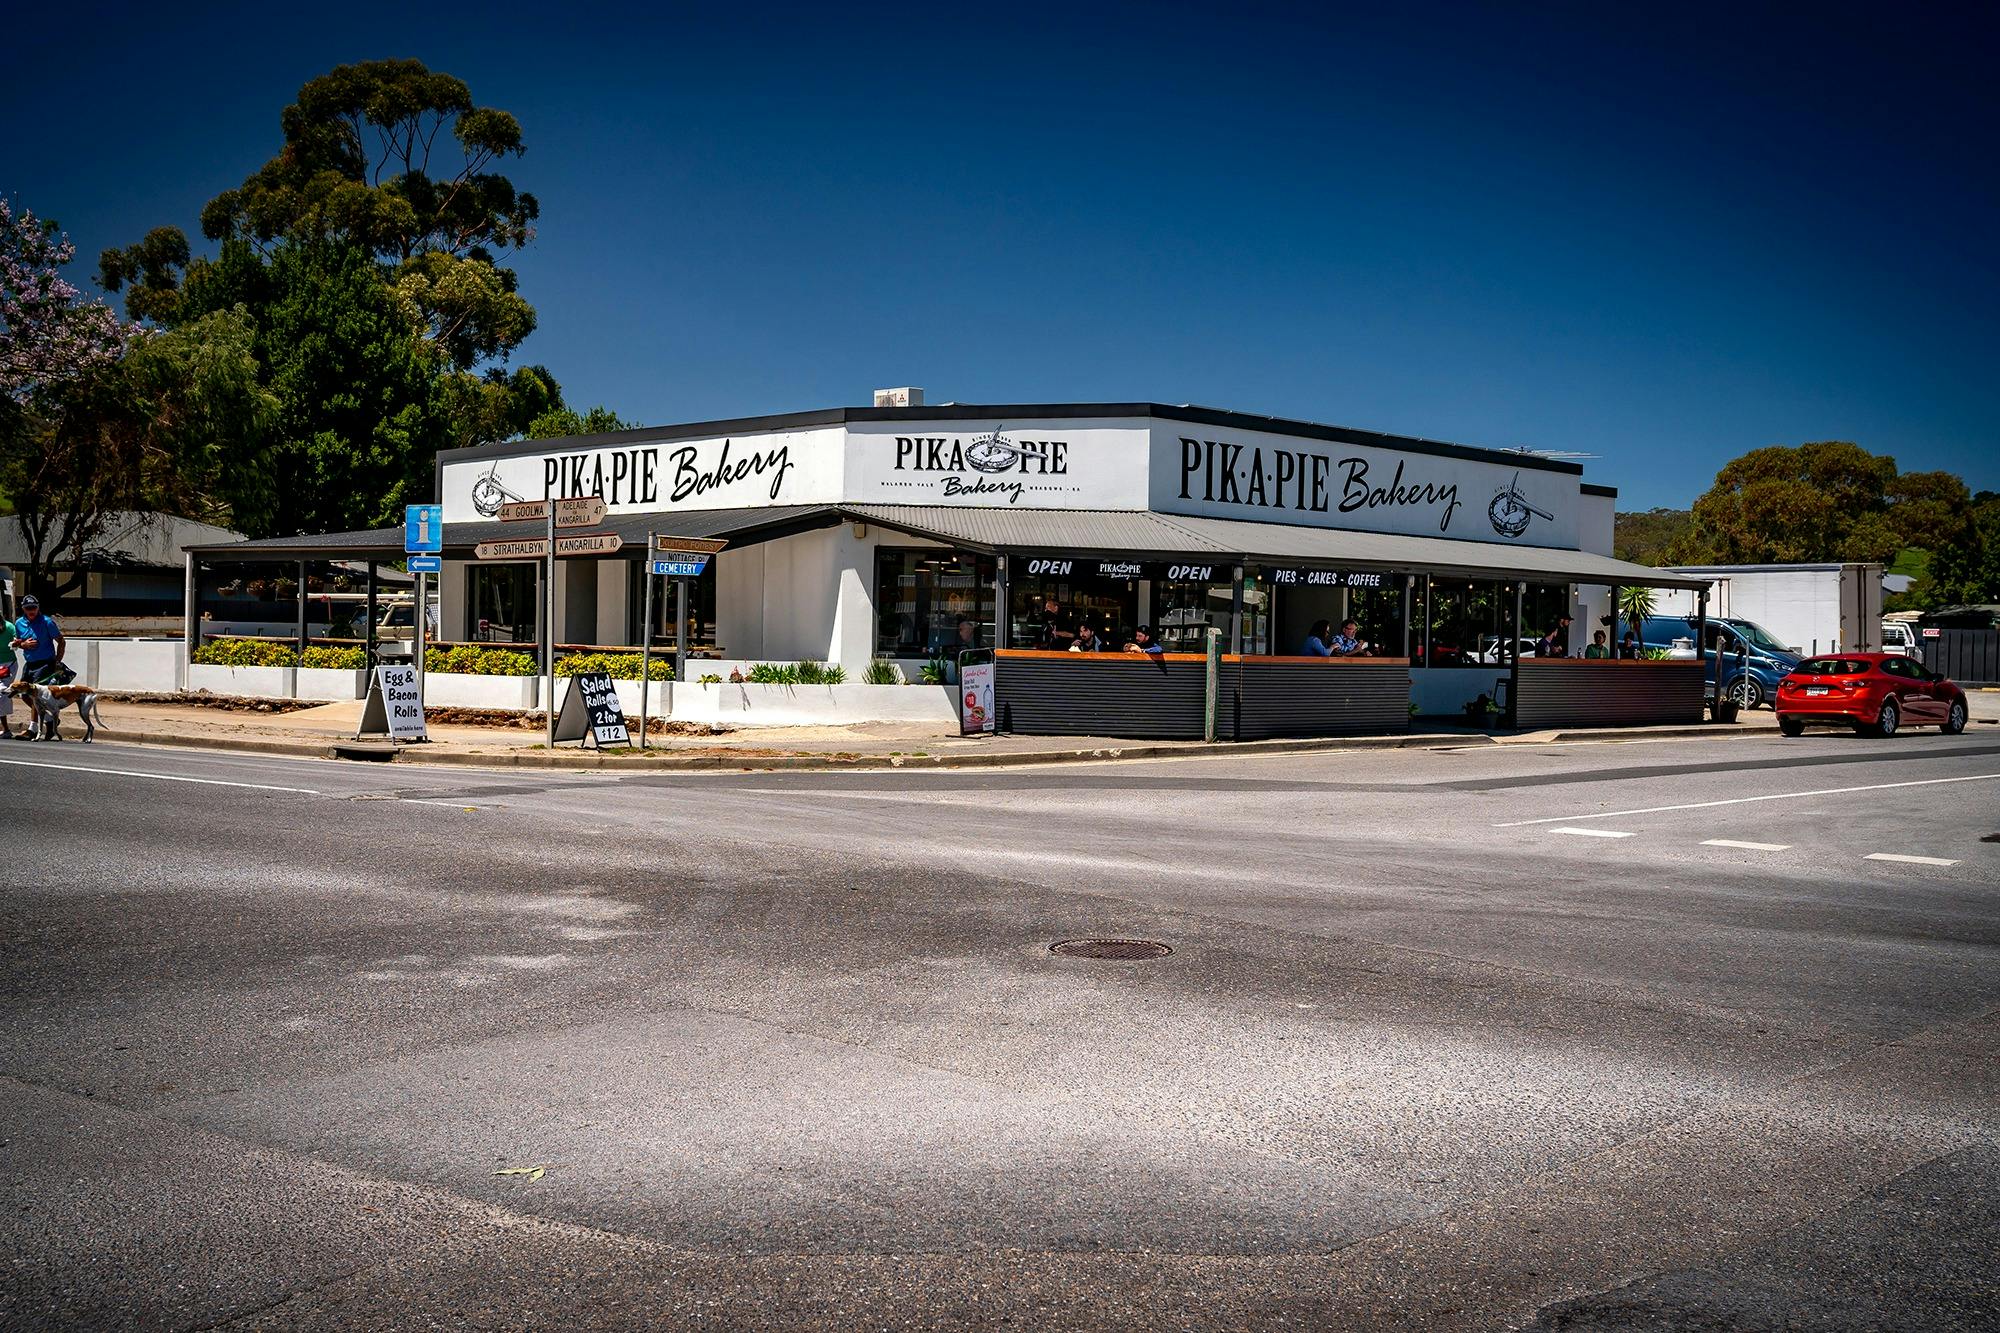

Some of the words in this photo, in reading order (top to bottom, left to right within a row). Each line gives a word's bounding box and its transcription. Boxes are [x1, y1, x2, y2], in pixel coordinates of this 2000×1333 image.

[1018, 440, 1068, 475] PIE
[669, 438, 794, 503] Bakery
[940, 475, 1026, 504] Bakery
[1338, 457, 1462, 532] Bakery
[500, 508, 510, 518] 44
[515, 505, 544, 517] GOOLWA
[562, 500, 588, 510] ADELAIDE
[594, 505, 602, 515] 47
[558, 514, 591, 525] KANGARILLA
[481, 546, 488, 555] 18
[493, 542, 544, 556] STRATHALBYN
[559, 538, 604, 551] KANGARILLA
[610, 538, 617, 548] 10
[660, 562, 697, 574] CEMETERY
[1028, 560, 1073, 575] OPEN
[1168, 565, 1212, 581] OPEN
[1275, 569, 1297, 583] PIES
[1307, 571, 1337, 585] CAKES
[1347, 573, 1381, 586] COFFEE
[385, 670, 404, 687] Egg
[405, 670, 414, 683] &
[580, 673, 612, 695] Salad
[388, 687, 418, 701] Bacon
[585, 693, 607, 708] Rolls
[394, 705, 418, 718] Rolls
[595, 711, 604, 724] 2
[604, 710, 617, 724] for
[602, 726, 621, 739] $12
